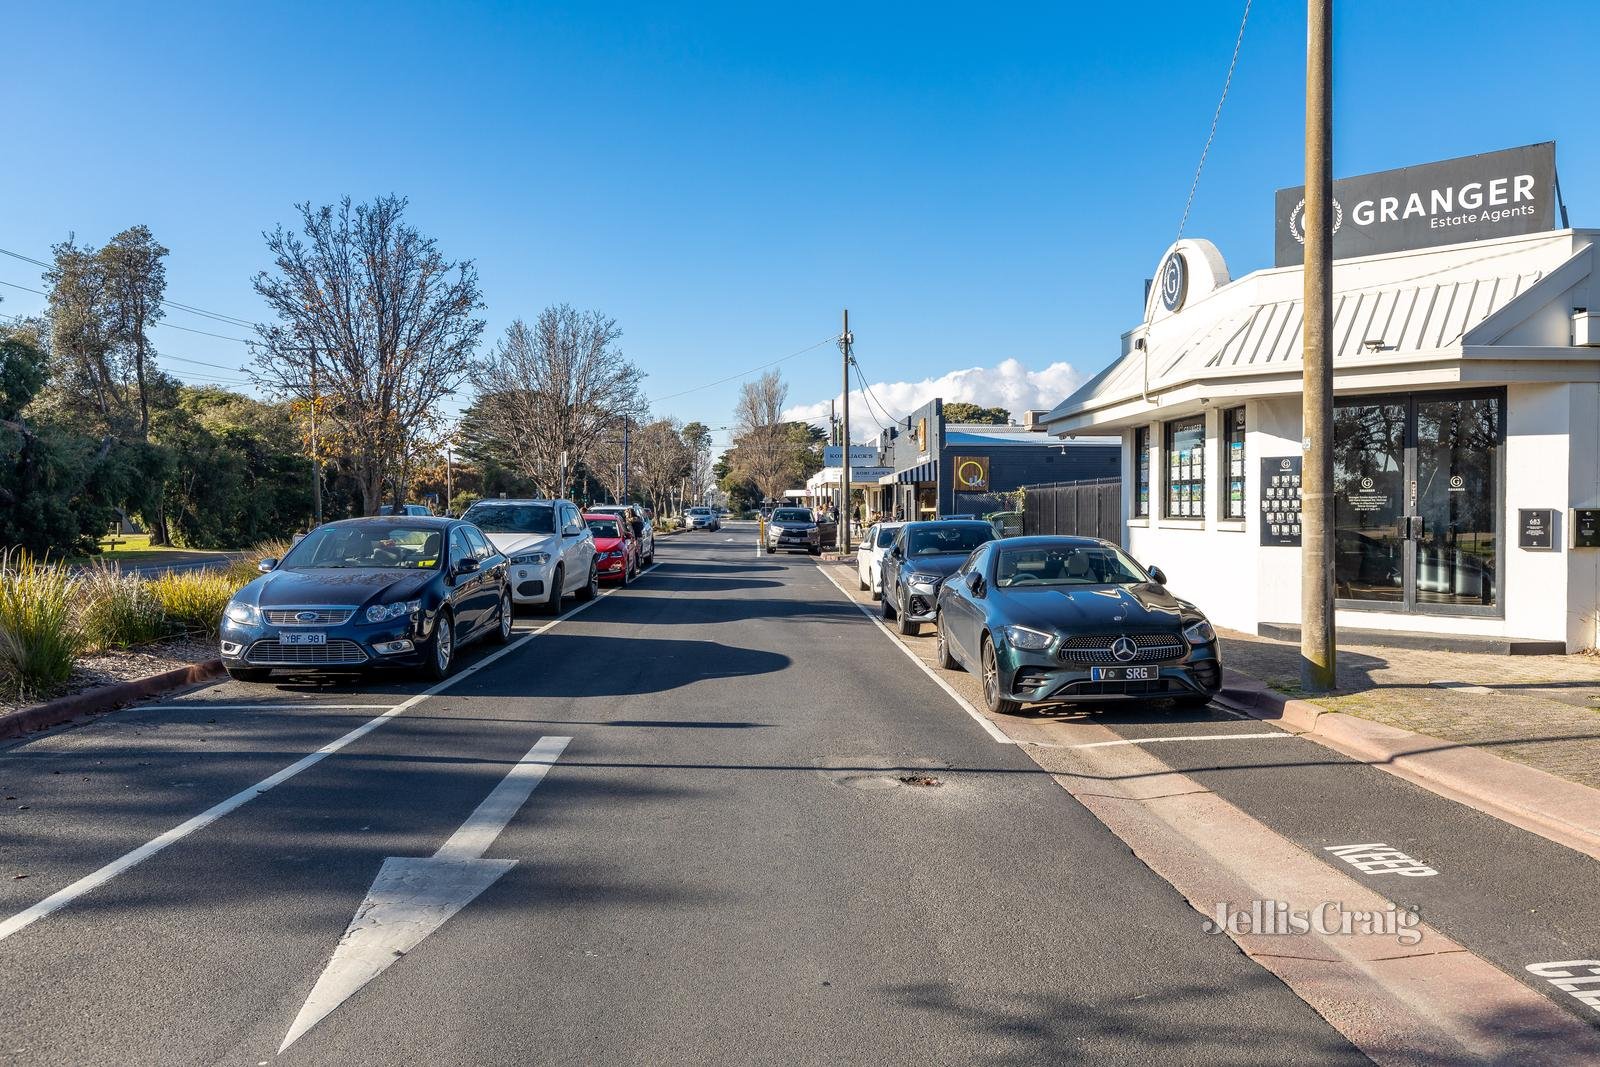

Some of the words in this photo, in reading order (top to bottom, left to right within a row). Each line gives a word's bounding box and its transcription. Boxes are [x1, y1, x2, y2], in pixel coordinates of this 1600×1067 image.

[1352, 174, 1535, 226] GRANGER
[1430, 213, 1477, 229] Estate
[1480, 205, 1535, 223] Agents
[1125, 667, 1148, 679] SRG
[1324, 842, 1440, 877] KEEP
